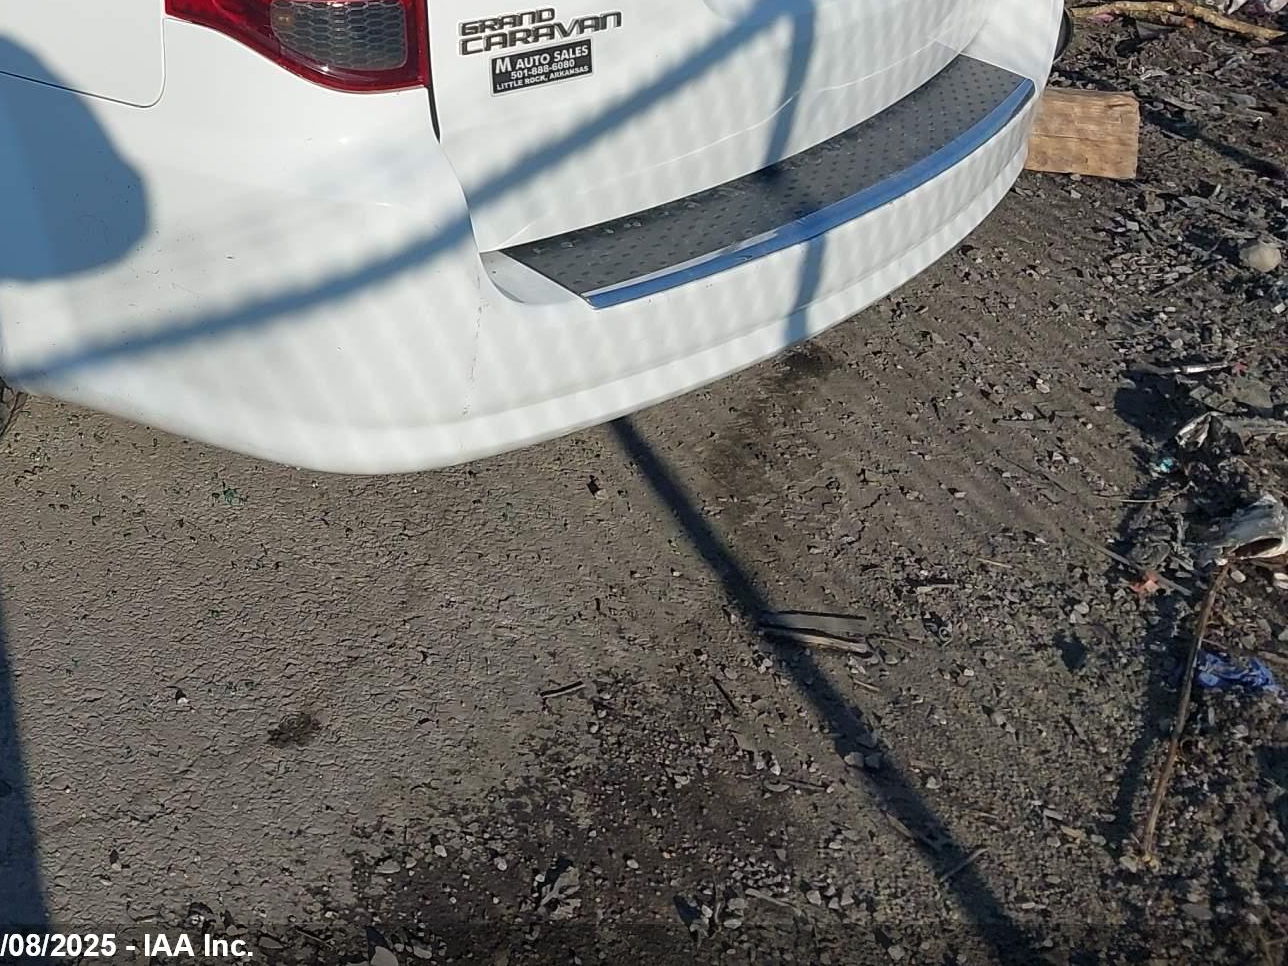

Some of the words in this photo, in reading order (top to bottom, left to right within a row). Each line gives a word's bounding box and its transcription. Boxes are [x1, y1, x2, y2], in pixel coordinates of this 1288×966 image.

[459, 7, 555, 36] GRAND
[459, 11, 622, 55] CARAVAN
[494, 56, 513, 75] M
[515, 53, 551, 70] AUTO
[553, 44, 589, 62] SALES
[510, 59, 576, 80] 501-888-6080
[496, 78, 523, 91] LITTLE
[524, 74, 549, 86] ROCK,
[549, 65, 590, 80] ARKANSAS
